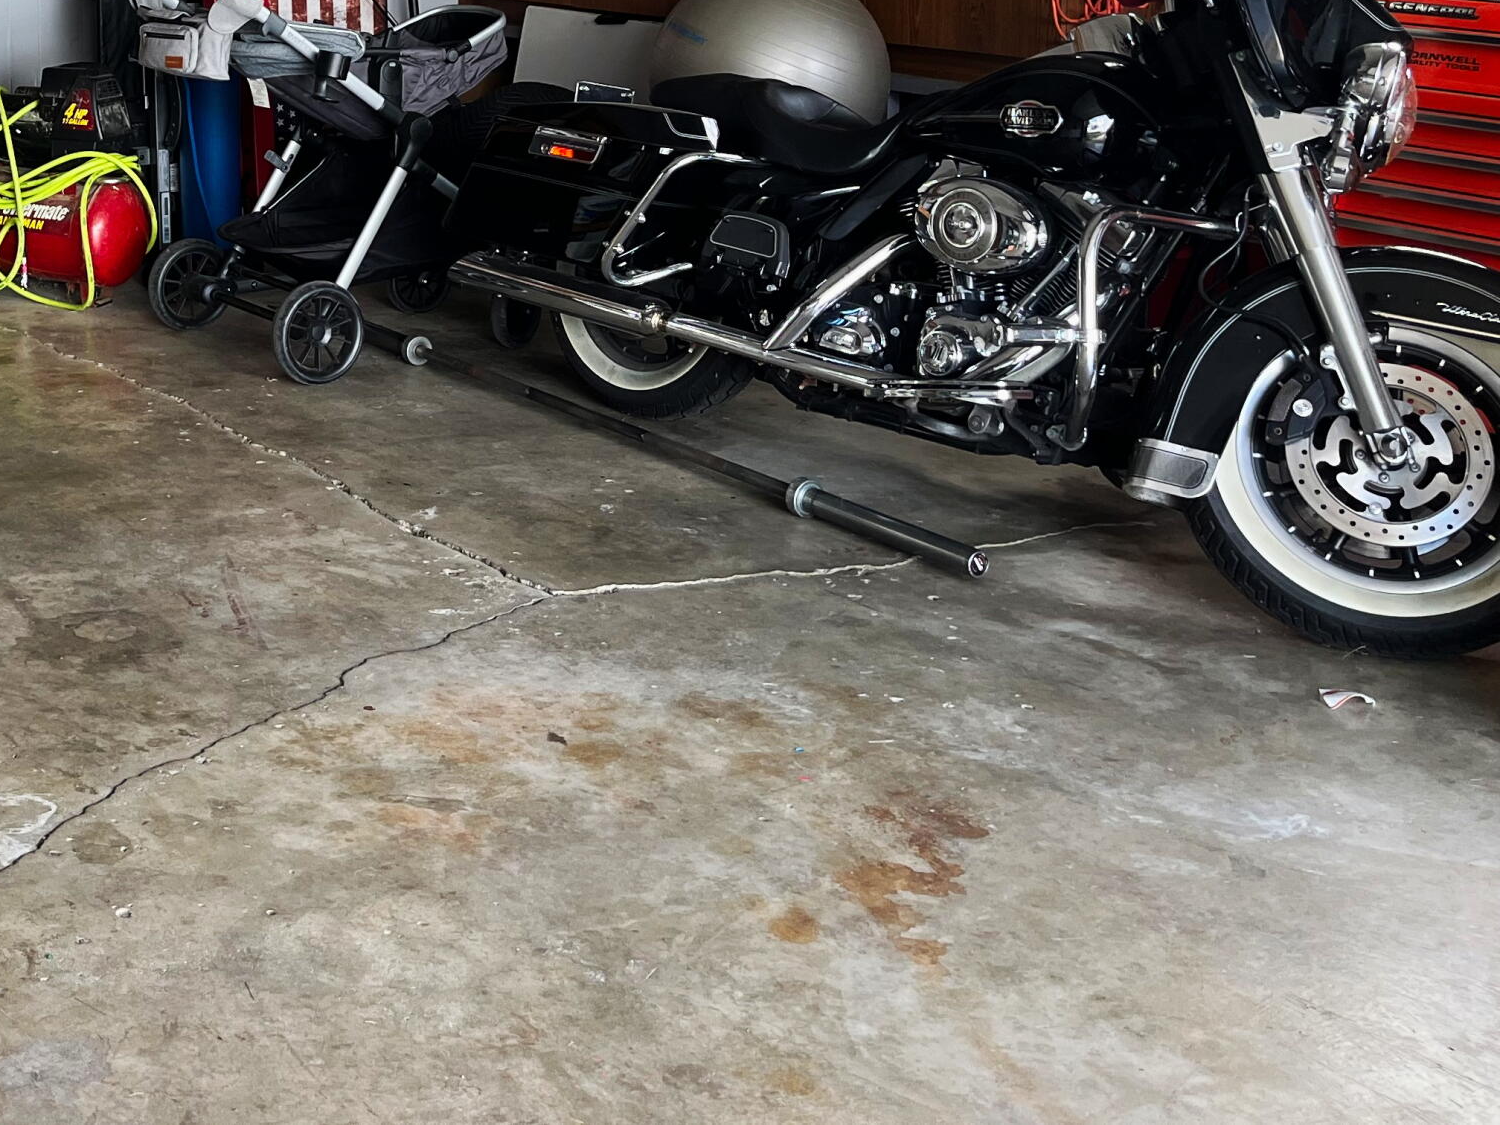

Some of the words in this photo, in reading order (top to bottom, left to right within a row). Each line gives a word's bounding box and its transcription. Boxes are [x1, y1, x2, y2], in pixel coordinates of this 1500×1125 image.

[1388, 1, 1476, 17] GENERAL
[1411, 52, 1482, 66] ORNWELL
[64, 103, 77, 118] 4
[74, 109, 89, 119] HP
